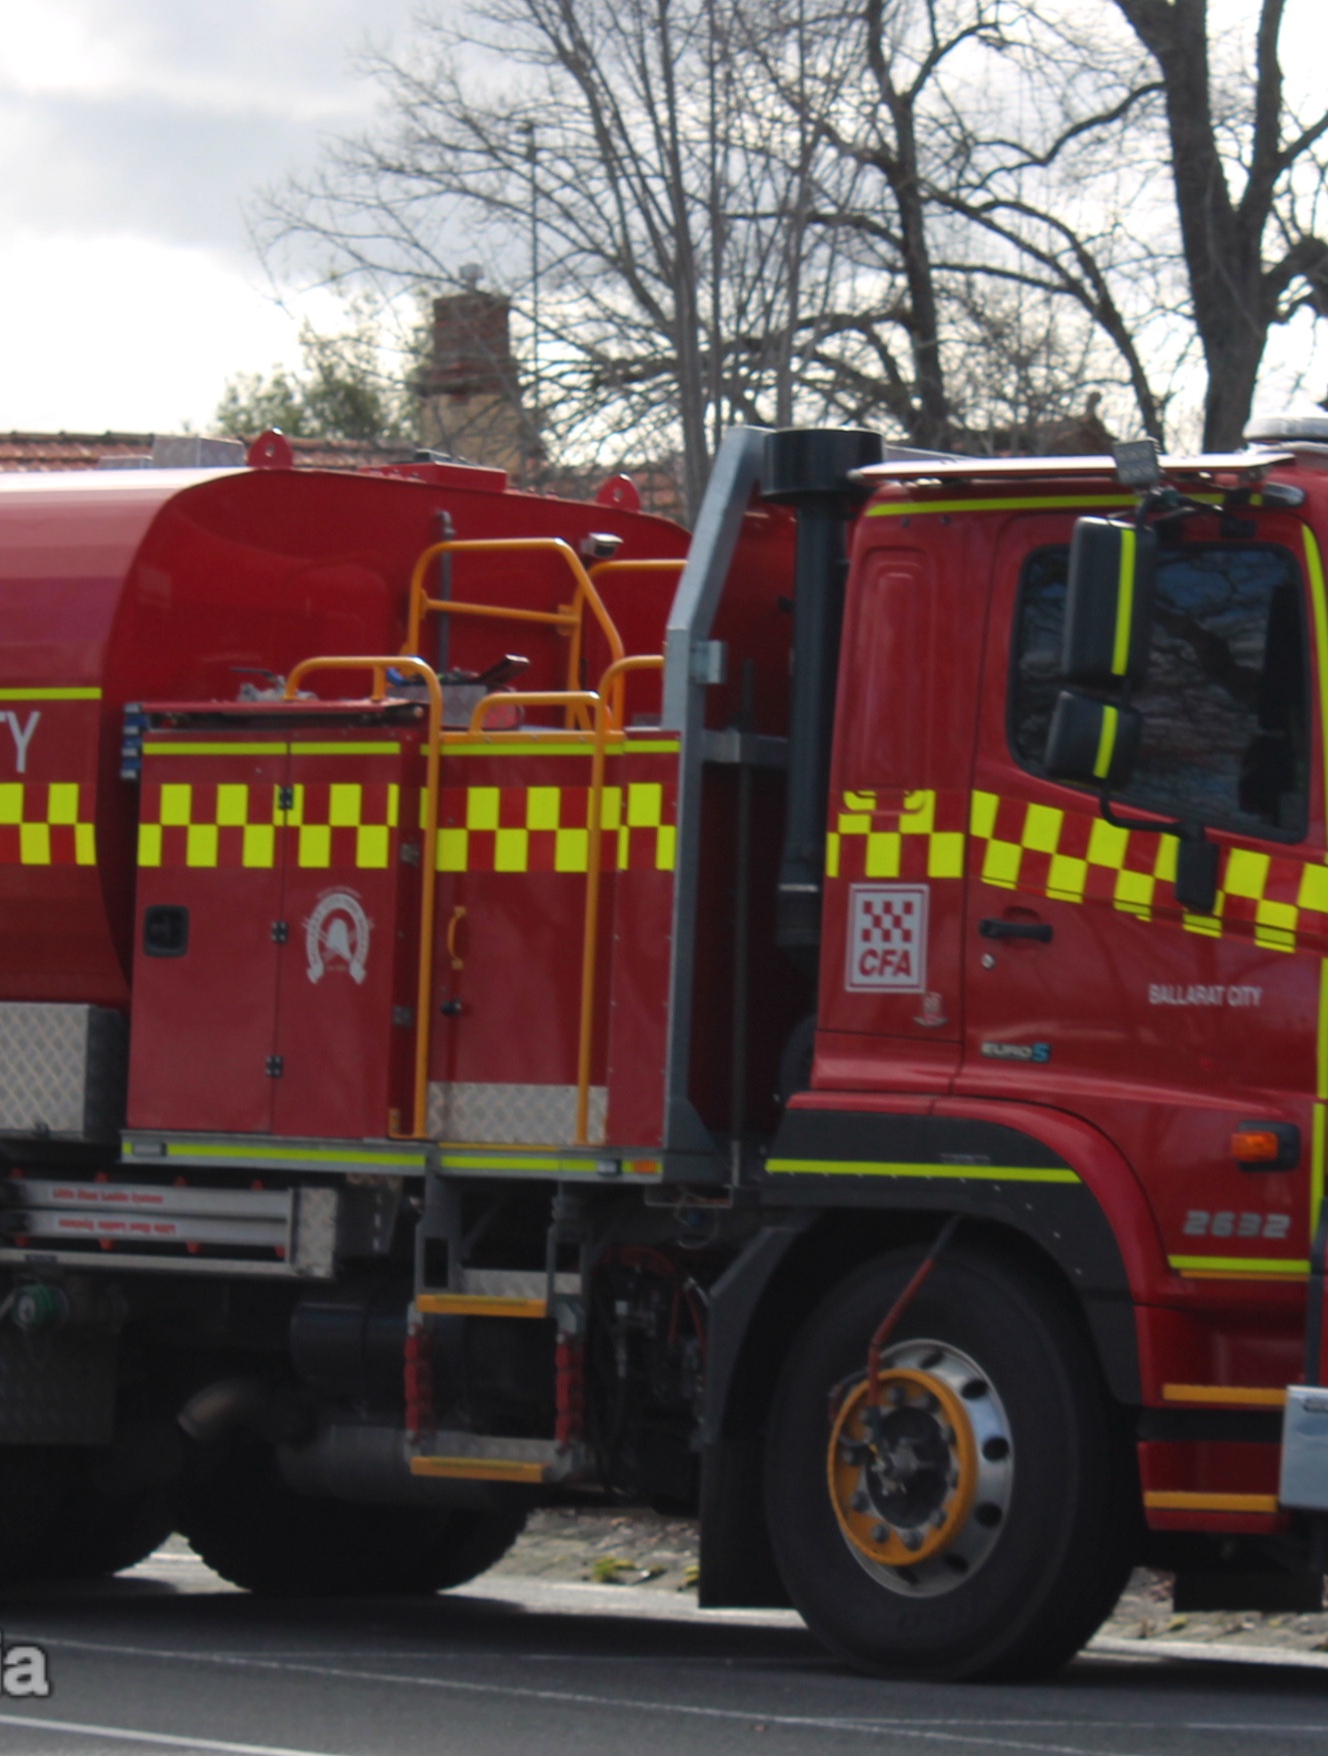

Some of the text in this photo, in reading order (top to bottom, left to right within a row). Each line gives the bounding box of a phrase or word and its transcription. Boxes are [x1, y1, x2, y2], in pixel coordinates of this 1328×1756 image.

[859, 948, 912, 977] CFA
[1148, 983, 1263, 1008] BALLARAT CITY
[1183, 1209, 1291, 1239] 2632
